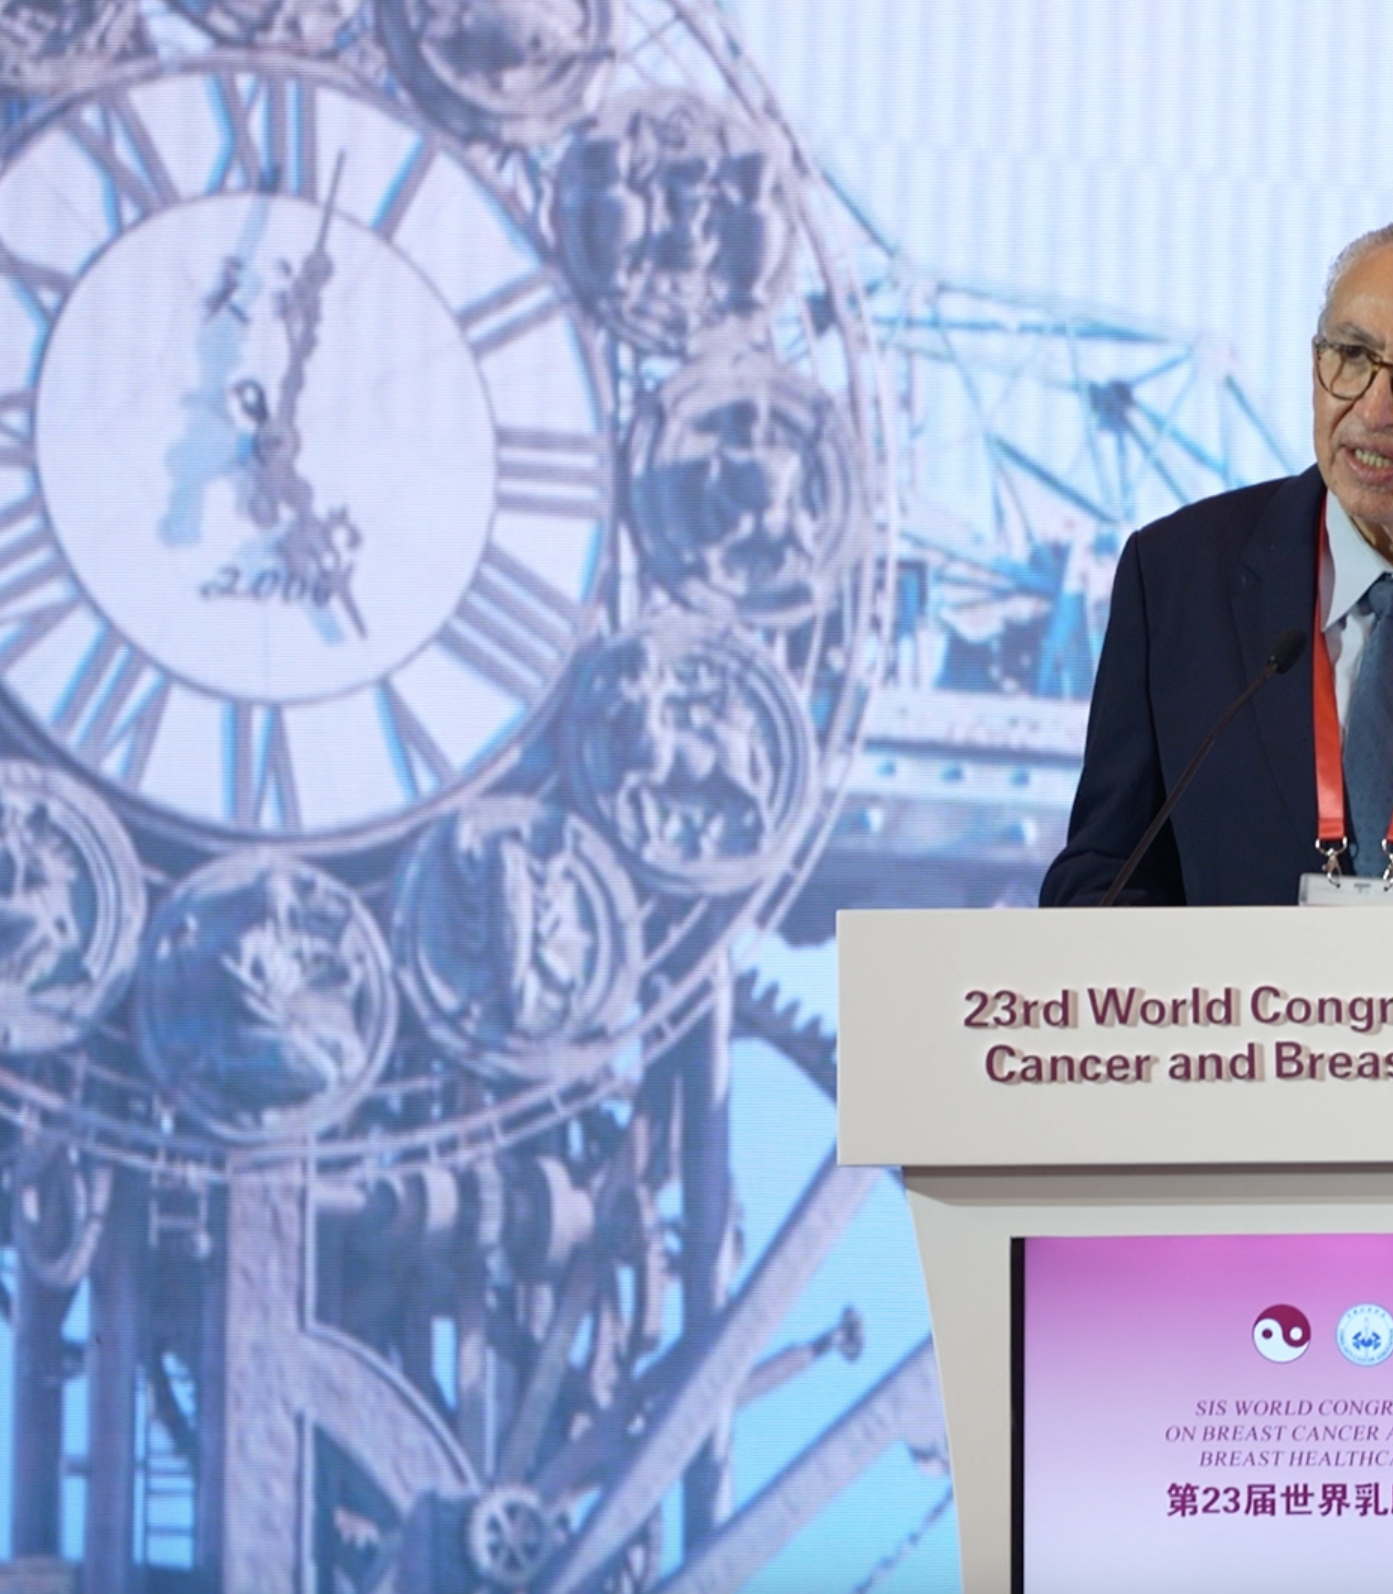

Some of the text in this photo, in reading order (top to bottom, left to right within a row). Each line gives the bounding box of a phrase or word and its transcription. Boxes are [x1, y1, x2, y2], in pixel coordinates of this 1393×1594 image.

[964, 988, 1072, 1028] 23rd
[1086, 986, 1233, 1026] World
[985, 1044, 1152, 1083] Cancer
[1167, 1042, 1257, 1081] and
[1195, 1400, 1227, 1416] SIS
[1235, 1400, 1313, 1416] WORLD
[1164, 1426, 1197, 1442] ON
[1201, 1426, 1287, 1442] BREAST
[1291, 1425, 1380, 1441] CANCER
[1199, 1451, 1286, 1467] BREAST
